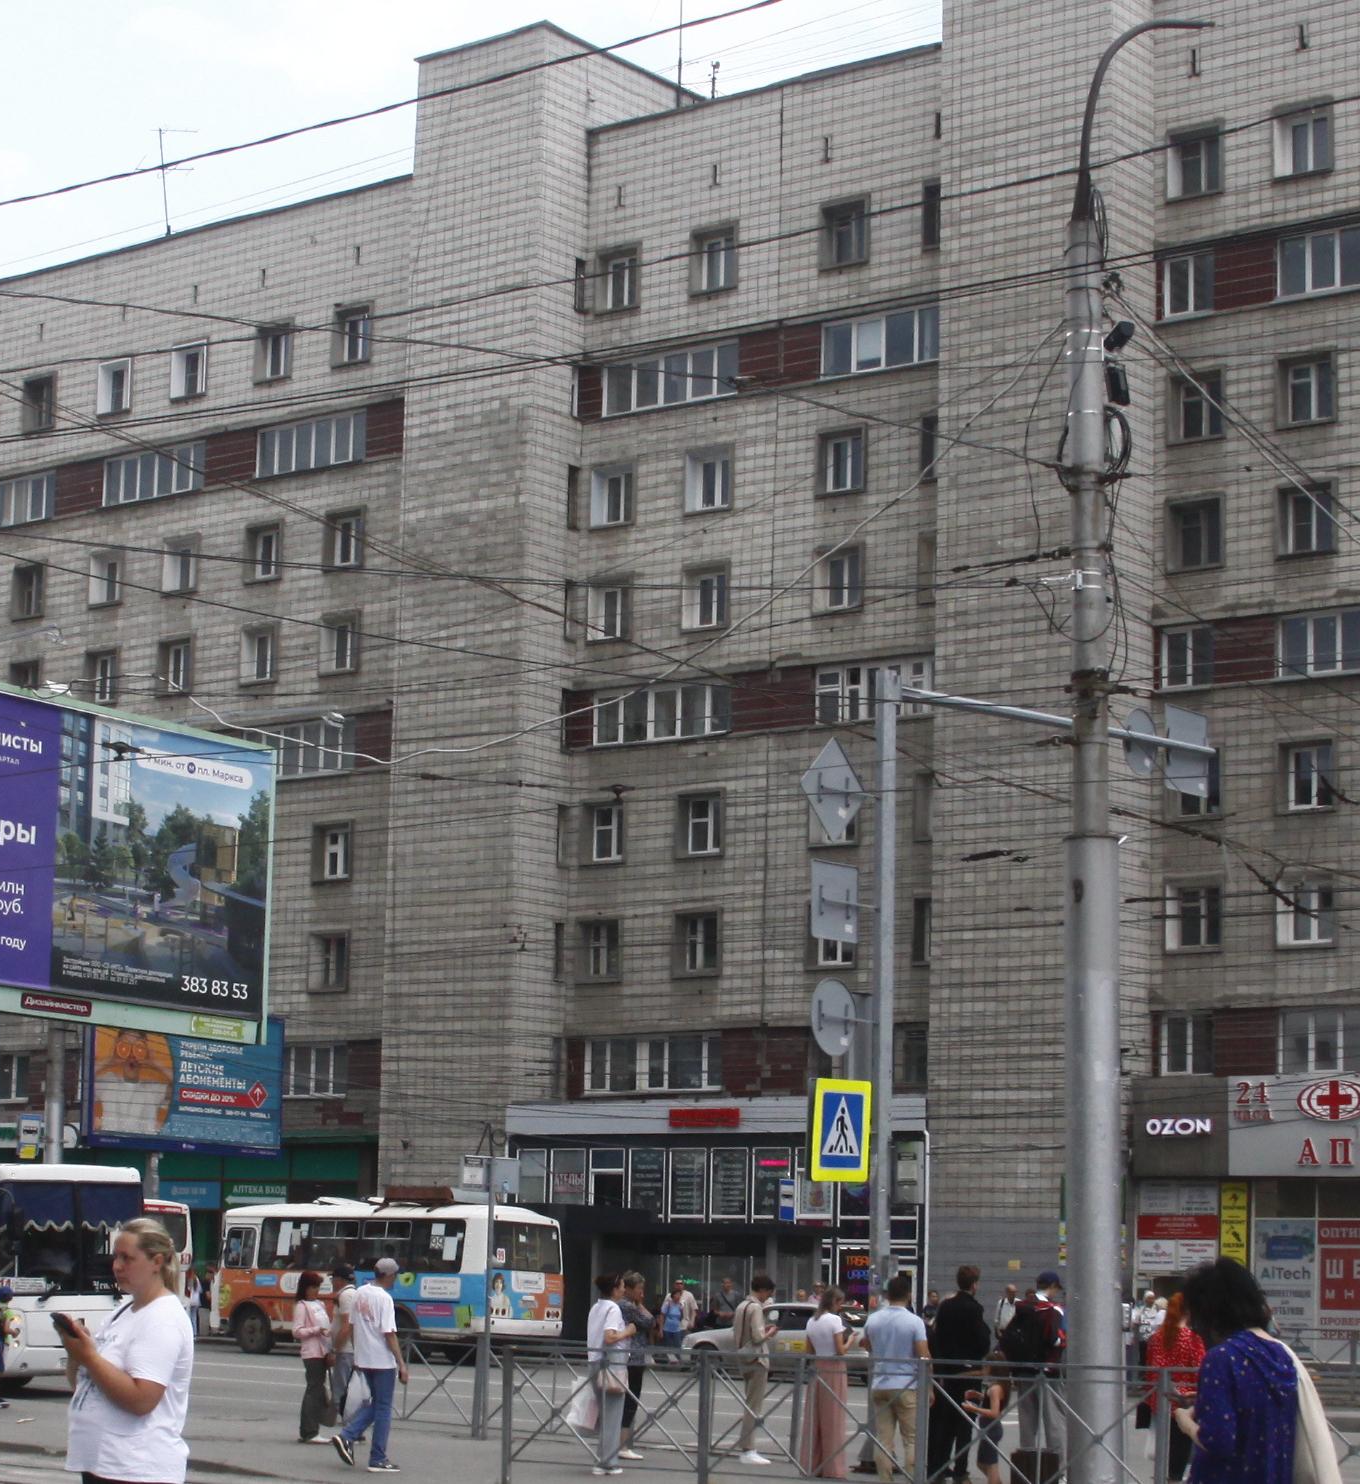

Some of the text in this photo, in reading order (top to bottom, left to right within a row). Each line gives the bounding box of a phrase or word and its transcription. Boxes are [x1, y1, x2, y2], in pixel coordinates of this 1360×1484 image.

[197, 767, 210, 776] пл.
[212, 769, 243, 784] Маркса
[0, 935, 26, 951] году
[181, 975, 248, 1000] 383 83 53
[179, 1061, 225, 1076] ДЕТСКИЕ
[179, 1074, 246, 1090] АБОНЕМЕНТЫ
[181, 1090, 210, 1101] СКИДКИ
[210, 1094, 220, 1102] ДО
[1236, 1081, 1268, 1105] 24
[1146, 1117, 1212, 1136] OZON
[232, 1184, 287, 1195] АПТЕКА ВХОД
[1326, 1259, 1344, 1279] Ш
